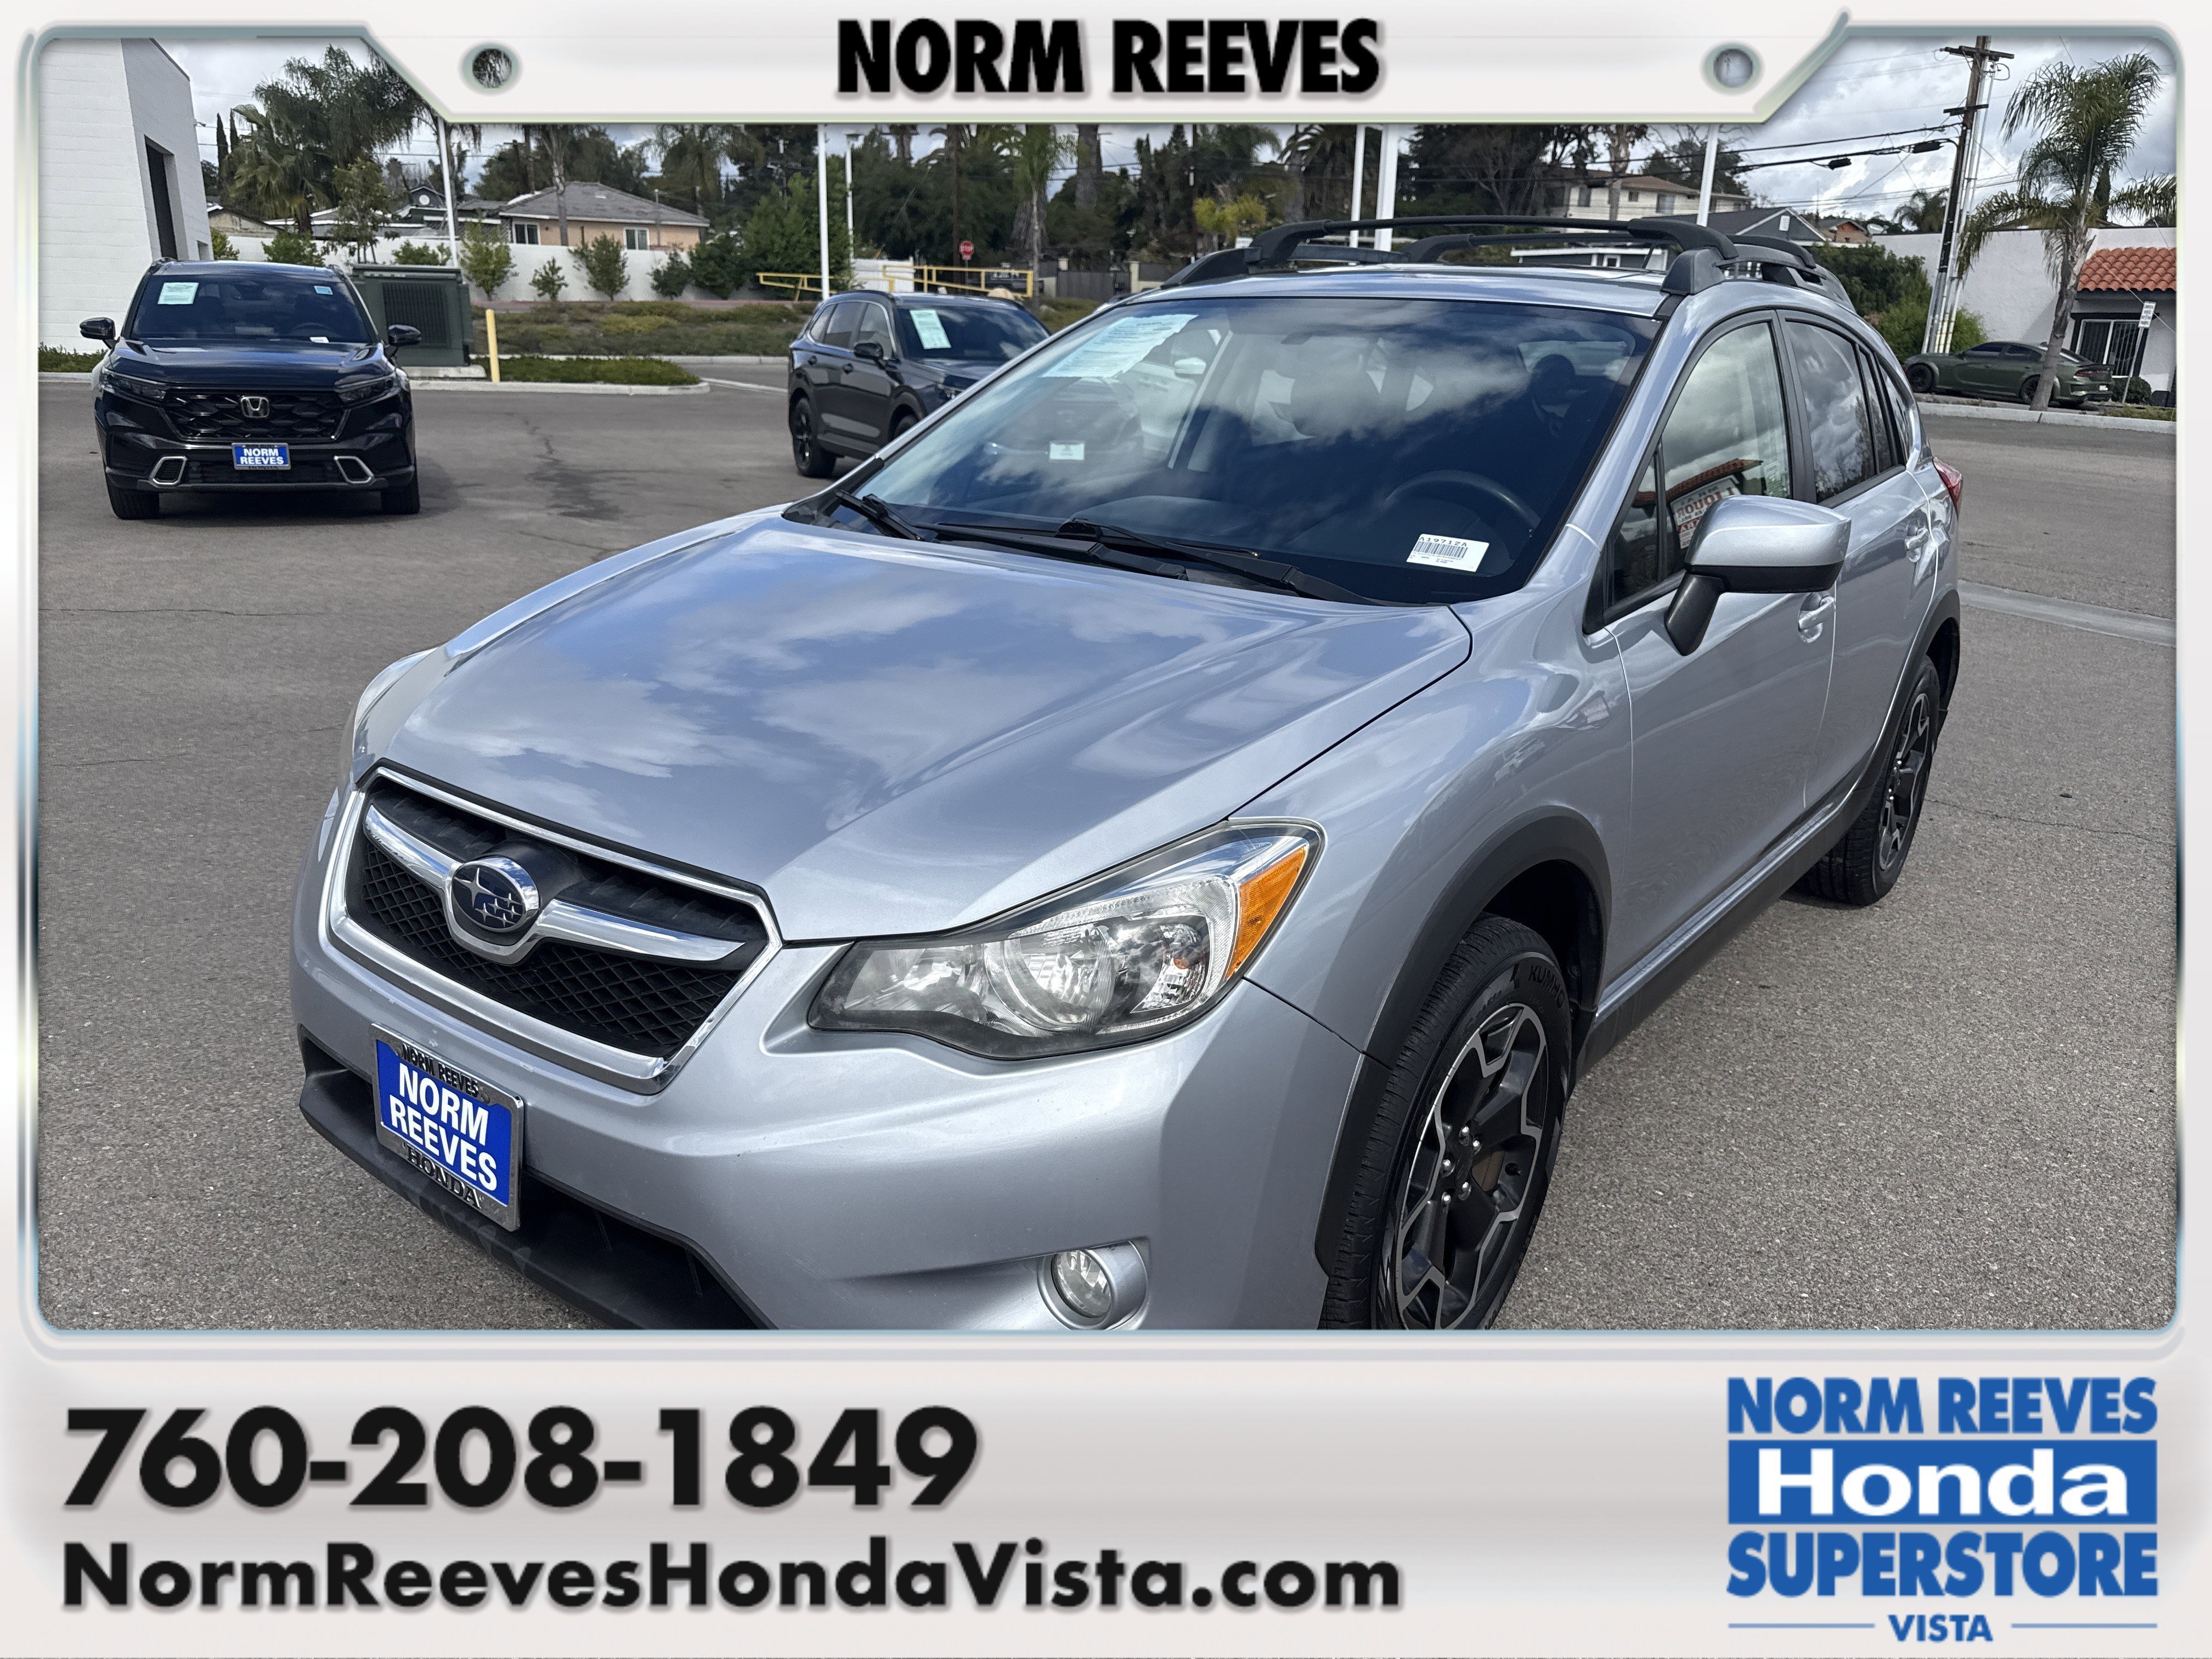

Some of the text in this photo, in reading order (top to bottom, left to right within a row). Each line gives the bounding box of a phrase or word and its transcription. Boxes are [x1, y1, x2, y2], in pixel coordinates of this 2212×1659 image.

[240, 456, 284, 465] REEVES
[243, 448, 279, 456] NORM
[1419, 537, 1467, 547] A19712A
[1528, 965, 1565, 1008] KUMHO
[402, 1043, 479, 1097] NORM REEVES
[399, 1062, 489, 1146] NORM
[390, 1094, 497, 1191] REEVES
[407, 1143, 481, 1209] HONDA
